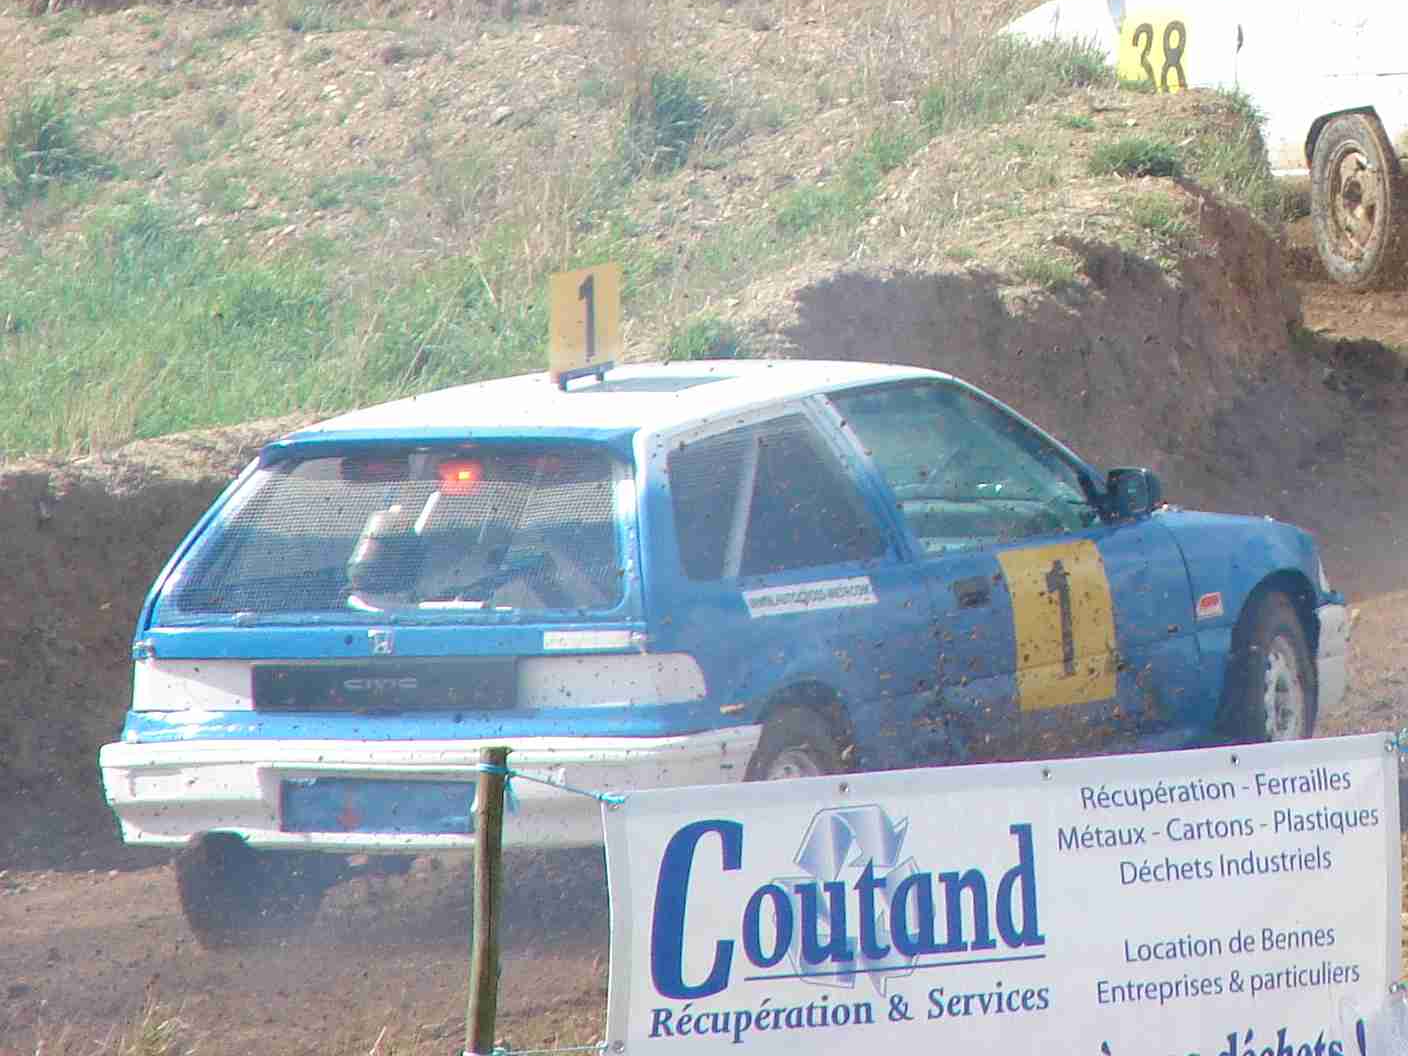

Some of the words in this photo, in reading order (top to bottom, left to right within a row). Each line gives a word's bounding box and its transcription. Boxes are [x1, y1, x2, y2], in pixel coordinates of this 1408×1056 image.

[1132, 20, 1188, 92] 38
[579, 274, 594, 362] 1
[1046, 560, 1074, 677] 1
[1080, 780, 1236, 812] Récupération
[1255, 767, 1352, 796] Ferrailles
[1057, 825, 1146, 852] Métaux
[1166, 815, 1255, 843] Cartons
[1273, 805, 1379, 836] Plastiques
[1119, 855, 1214, 885] Déchets
[1219, 845, 1332, 877] Industriels
[651, 818, 1046, 1000] Coutand
[1124, 934, 1223, 963] Location
[1228, 930, 1255, 953] de
[1261, 927, 1336, 952] Bennes
[1096, 972, 1224, 1006] Entreprises
[1229, 969, 1245, 994] &
[1250, 960, 1361, 995] particuliers
[648, 993, 874, 1043] Récupération
[887, 993, 913, 1022] &
[927, 981, 1050, 1020] Services
